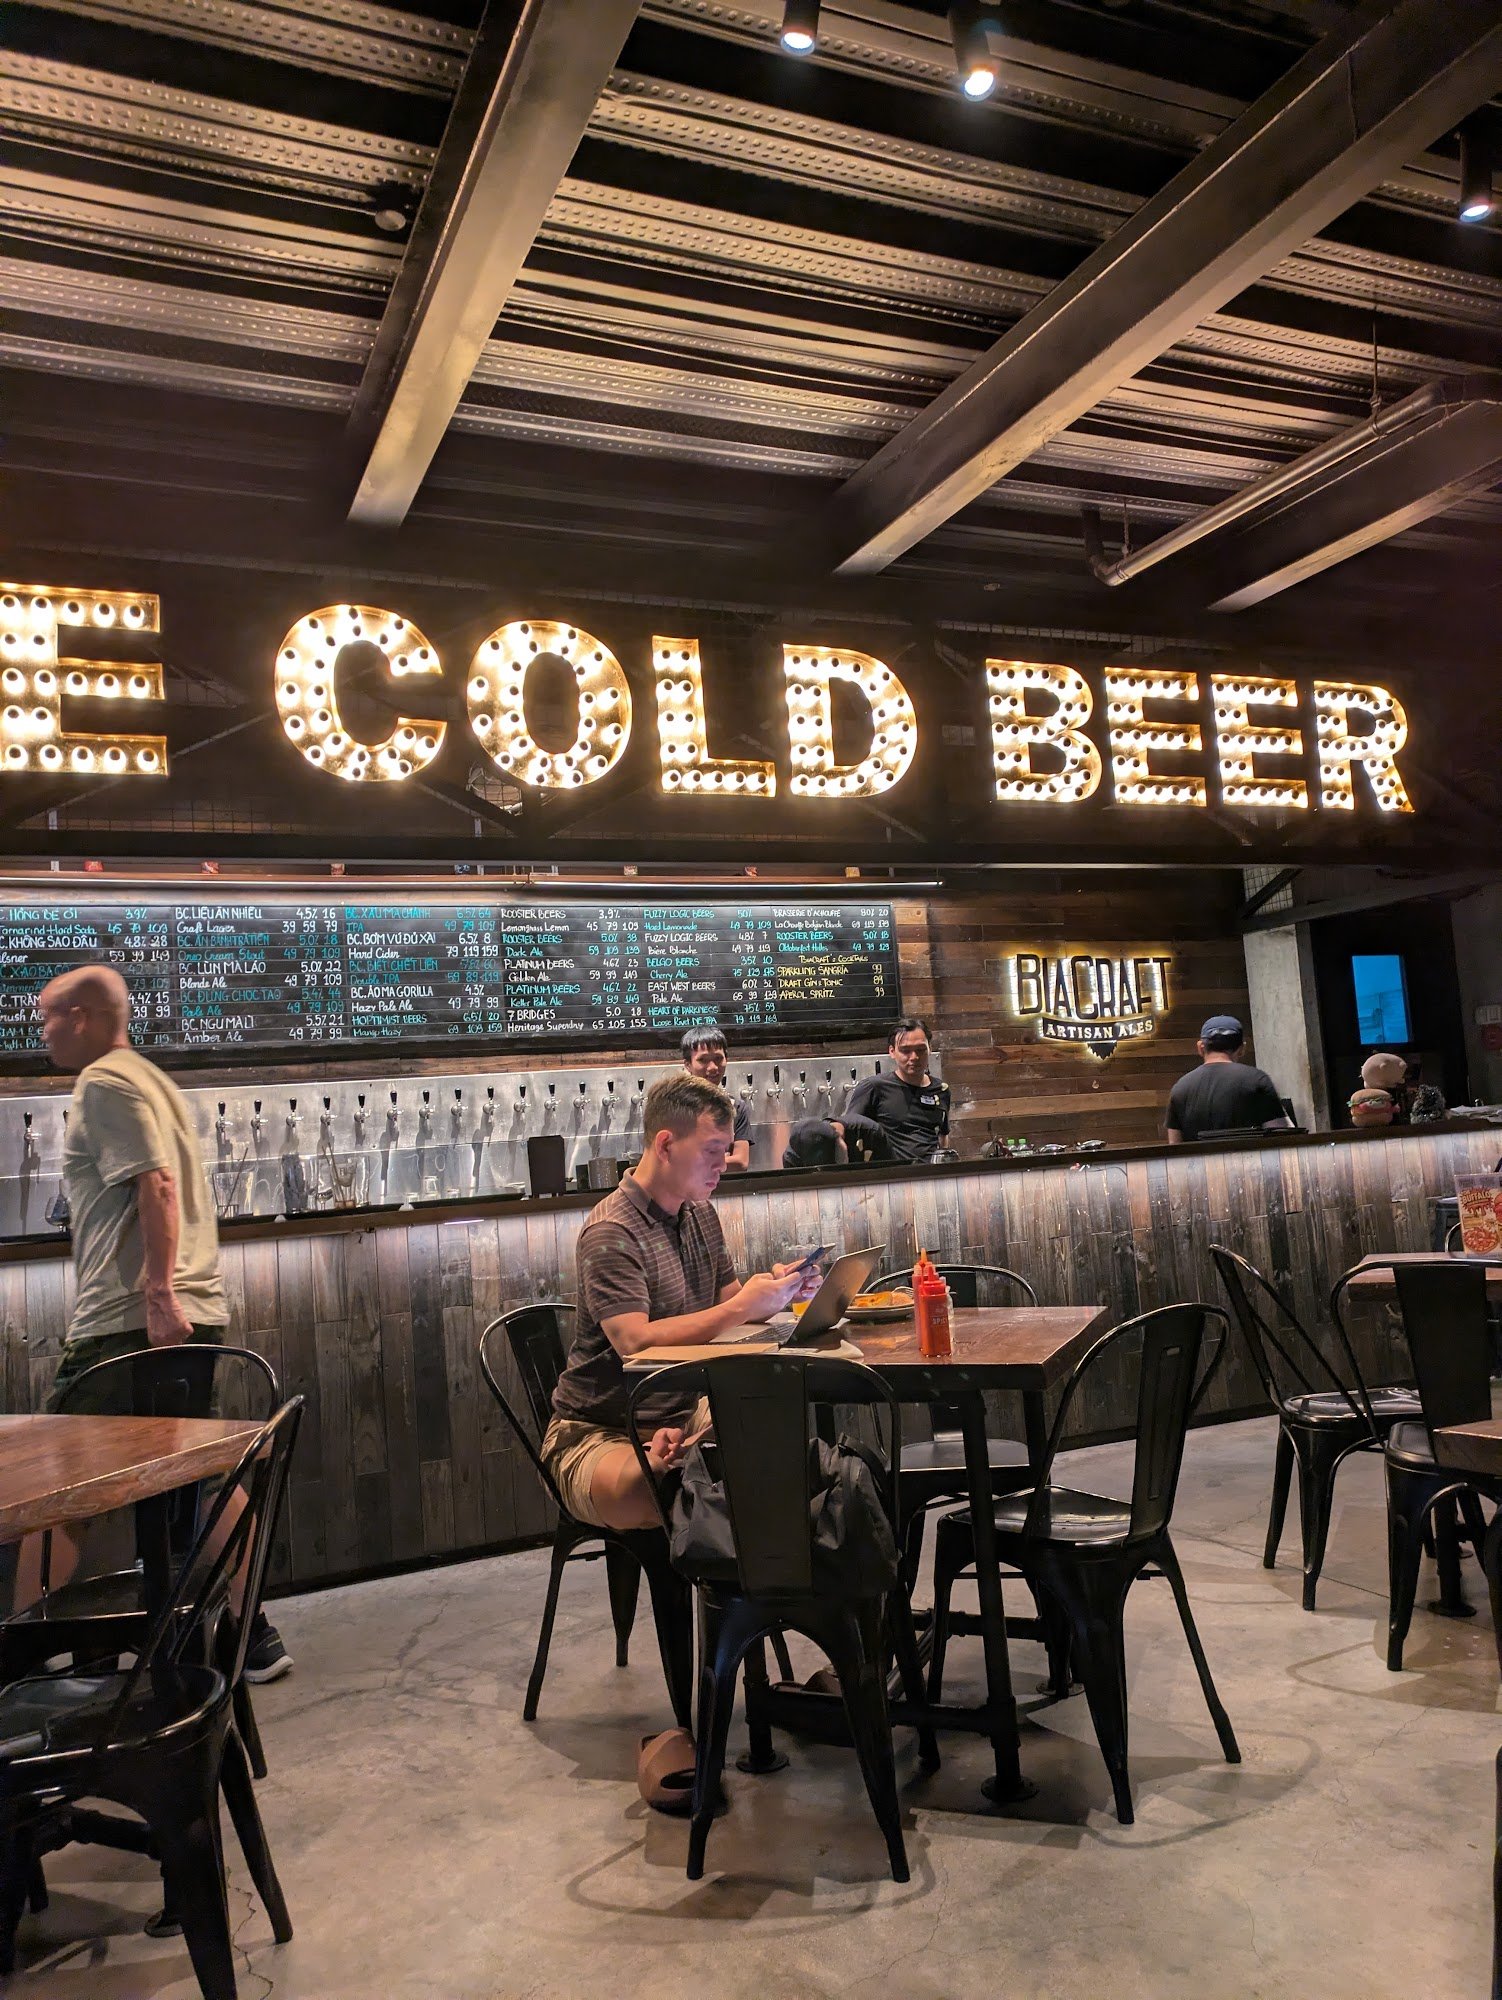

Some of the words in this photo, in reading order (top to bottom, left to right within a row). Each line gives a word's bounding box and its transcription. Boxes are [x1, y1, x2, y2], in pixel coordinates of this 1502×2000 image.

[0, 582, 168, 777] E
[274, 603, 919, 798] COLD
[985, 658, 1415, 814] BEER
[296, 908, 317, 919] 4.5%
[323, 908, 335, 919] 16
[501, 909, 536, 918] ROOSTER
[538, 909, 566, 918] BEERS
[599, 909, 620, 918] 3.9%
[644, 910, 667, 919] FUZZY
[670, 910, 690, 918] LOGIC
[692, 909, 714, 918] BEERS
[773, 909, 805, 917] BRASSERIE
[108, 924, 122, 933] 45
[177, 922, 203, 933] Craft
[207, 921, 235, 933] Lager
[282, 921, 295, 932] 39
[303, 921, 315, 932] 59
[324, 921, 337, 932] 79
[463, 922, 474, 930] 79
[587, 923, 598, 931] 45
[607, 922, 617, 930] 79
[623, 922, 638, 930] 109
[663, 922, 697, 930] Lemonade
[459, 934, 477, 944] 6.5%
[484, 934, 490, 944] 8
[503, 934, 534, 943] ROOSTER
[538, 934, 562, 943] BEERS
[645, 933, 668, 942] FUZZY
[670, 933, 693, 942] LOGIC
[695, 933, 718, 942] BEERS
[762, 932, 767, 940] 7
[776, 932, 808, 940] ROOSTER
[811, 931, 833, 940] BEERS
[881, 931, 889, 939] 18
[48, 936, 70, 947] SAO
[853, 943, 861, 951] 49
[110, 951, 125, 961] 59
[151, 951, 169, 961] 149
[284, 949, 296, 959] 49
[322, 948, 340, 959] 109
[349, 948, 372, 959] Hard
[376, 948, 400, 958] Cider
[446, 947, 458, 957] 79
[464, 947, 479, 957] 119
[482, 946, 498, 957] 159
[507, 947, 526, 956] Dark
[589, 946, 599, 955] 59
[301, 961, 322, 972] 5.0%
[325, 961, 342, 972] 22
[504, 959, 544, 969] PLATINUM
[547, 959, 574, 968] BEERS
[628, 959, 638, 967] 23
[646, 958, 672, 967] BELGO
[676, 958, 699, 966] BEERS
[763, 956, 772, 964] 10
[537, 971, 550, 981] Ale
[590, 971, 600, 979] 59
[606, 971, 616, 979] 99
[623, 970, 637, 979] 149
[650, 970, 672, 981] Cherry
[676, 970, 688, 979] Ale
[778, 966, 816, 976] SPARKLING
[872, 964, 882, 974] 99
[180, 977, 210, 989] Blonde
[212, 977, 227, 988] Ale
[285, 975, 297, 986] 49
[305, 975, 316, 986] 79
[323, 974, 341, 985] 109
[384, 974, 400, 983] IPA
[780, 979, 801, 987] DRAFT
[382, 987, 395, 997] MA
[465, 985, 484, 995] 4.3%
[505, 985, 550, 995] PLATINUM
[553, 984, 580, 993] BEERS
[627, 983, 636, 991] 22
[648, 982, 668, 991] EAST
[671, 982, 689, 990] WEST
[692, 981, 716, 990] BEERS
[1017, 954, 1171, 1019] BIACRAFT
[128, 993, 150, 1004] 4.4%
[156, 992, 169, 1003] 15
[652, 994, 668, 1003] Pale
[671, 993, 683, 1002] Ale
[733, 992, 743, 1001] 65
[749, 991, 757, 999] 99
[779, 990, 807, 999] APEROL
[352, 1002, 376, 1012] Hazy
[379, 1001, 397, 1011] Pale
[399, 999, 413, 1010] Ale
[448, 998, 460, 1009] 49
[468, 998, 480, 1008] 79
[487, 997, 498, 1008] 99
[533, 997, 547, 1006] Pale
[550, 997, 563, 1006] Ale
[592, 995, 601, 1004] 59
[607, 995, 618, 1004] 89
[624, 995, 639, 1004] 149
[133, 1007, 147, 1018] 39
[156, 1006, 170, 1017] 99
[207, 1005, 222, 1015] Ale
[507, 1010, 514, 1018] 7
[517, 1009, 555, 1021] BRIDGES
[606, 1007, 621, 1016] 5.0
[631, 1007, 641, 1016] 18
[648, 1007, 670, 1015] HEART
[672, 1006, 680, 1015] OF
[306, 1015, 326, 1026] 5.5%
[329, 1015, 344, 1026] 21
[352, 1014, 400, 1025] HOPTIMIST
[403, 1014, 427, 1023] BEERS
[488, 1012, 499, 1020] 20
[488, 1023, 502, 1032] 159
[507, 1022, 543, 1032] Heritage
[592, 1020, 604, 1029] 65
[608, 1020, 625, 1029] 105
[630, 1019, 647, 1028] 155
[1046, 1023, 1113, 1039] ARTISAN
[1118, 1019, 1153, 1036] ALES
[184, 1032, 220, 1043] Amber
[226, 1031, 243, 1042] Ale
[289, 1029, 303, 1040] 49
[310, 1029, 322, 1039] 79
[329, 1028, 342, 1039] 99
[1461, 1190, 1491, 1203] BUFFALO
